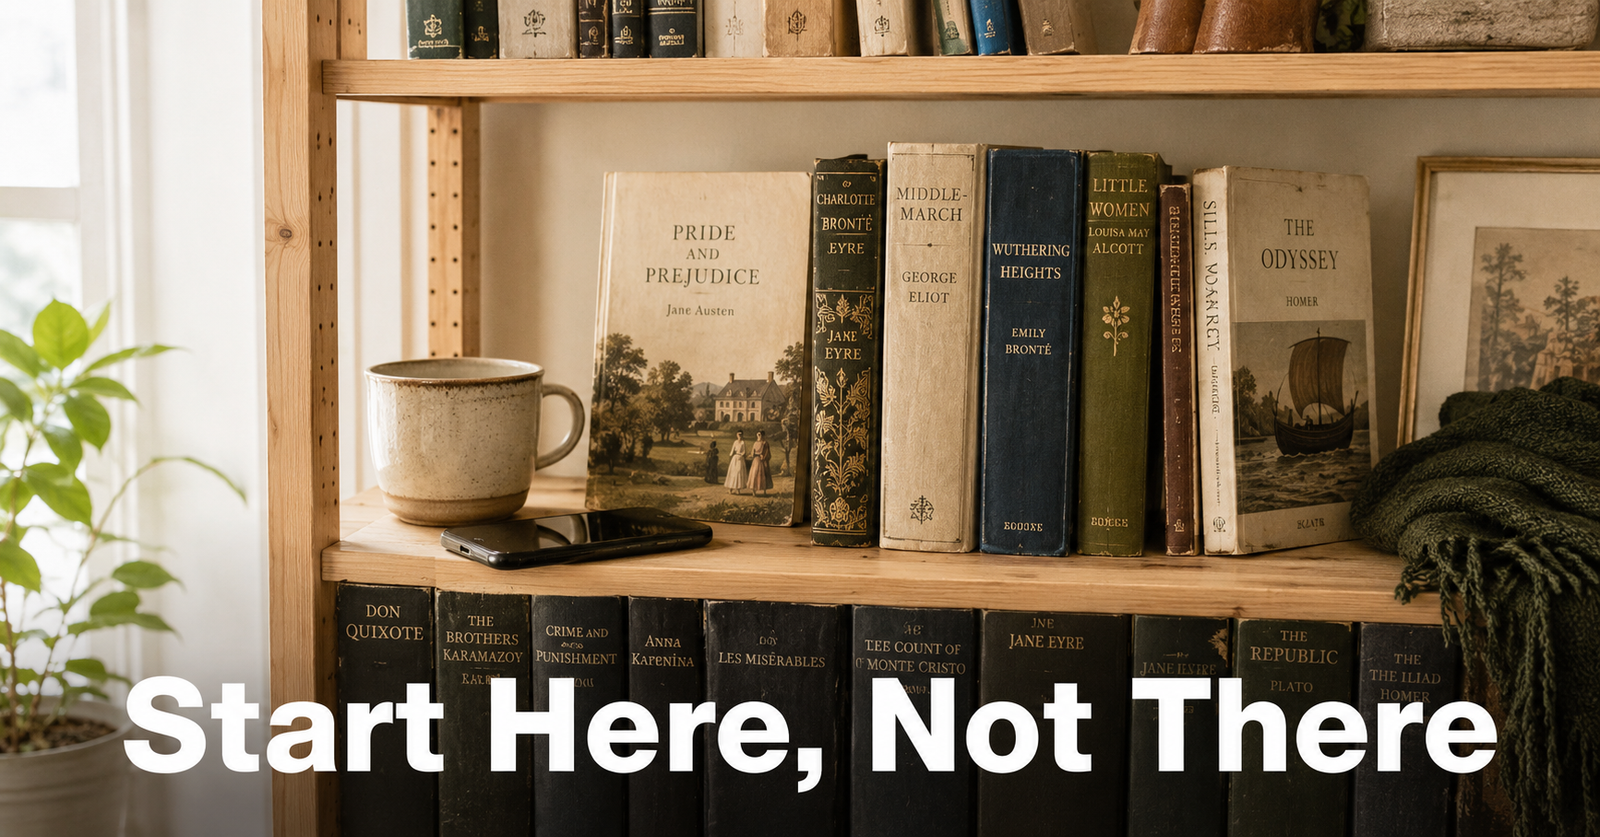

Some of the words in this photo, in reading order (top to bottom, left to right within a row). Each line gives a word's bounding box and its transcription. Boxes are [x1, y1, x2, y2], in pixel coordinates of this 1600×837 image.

[816, 193, 876, 206] CHARLOTTE
[896, 187, 968, 202] MIDDLE-
[899, 206, 963, 222] MARCH
[1089, 201, 1151, 217] WOMEN
[673, 224, 736, 241] PRIDE
[1088, 226, 1125, 238] LOUISA
[1127, 227, 1150, 238] MAY
[1283, 218, 1315, 237] THE
[685, 247, 720, 260] AND
[992, 243, 1071, 257] WUTHERING
[1092, 242, 1145, 255] ALCOTT
[1261, 248, 1339, 270] ODYSSEY
[645, 267, 760, 288] PREJUDICE
[901, 270, 957, 284] GEORGE
[1000, 265, 1062, 280] HEIGHTS
[908, 291, 949, 304] ELIOT
[1286, 295, 1319, 307] HOMER
[666, 303, 692, 317] Jane
[694, 304, 735, 316] Austen
[1011, 327, 1046, 338] EMILY
[824, 346, 862, 360] EYRE
[1005, 343, 1052, 355] BRONTÉ
[366, 604, 401, 618] DON
[467, 615, 494, 627] THE
[345, 623, 424, 641] QUIXOTE
[545, 624, 584, 638] CRIME
[585, 628, 609, 638] AND
[1280, 630, 1308, 642] THE
[445, 631, 519, 646] BROTHERS
[1008, 633, 1044, 650] JANE
[1047, 635, 1085, 650] EYRE
[894, 641, 942, 655] COUNT
[944, 643, 961, 655] OF
[535, 649, 618, 665] PUNISHMENT
[718, 652, 742, 665] LES
[1250, 646, 1339, 665] REPUBLIC
[1393, 653, 1422, 665] THE
[867, 657, 915, 672] MONTE
[918, 661, 966, 675] CRISTO
[1140, 662, 1175, 677] JANE
[1369, 669, 1398, 682] THE
[1401, 672, 1442, 684] ILIAD
[1270, 680, 1313, 693] PLATO
[1380, 688, 1431, 703] HOMER
